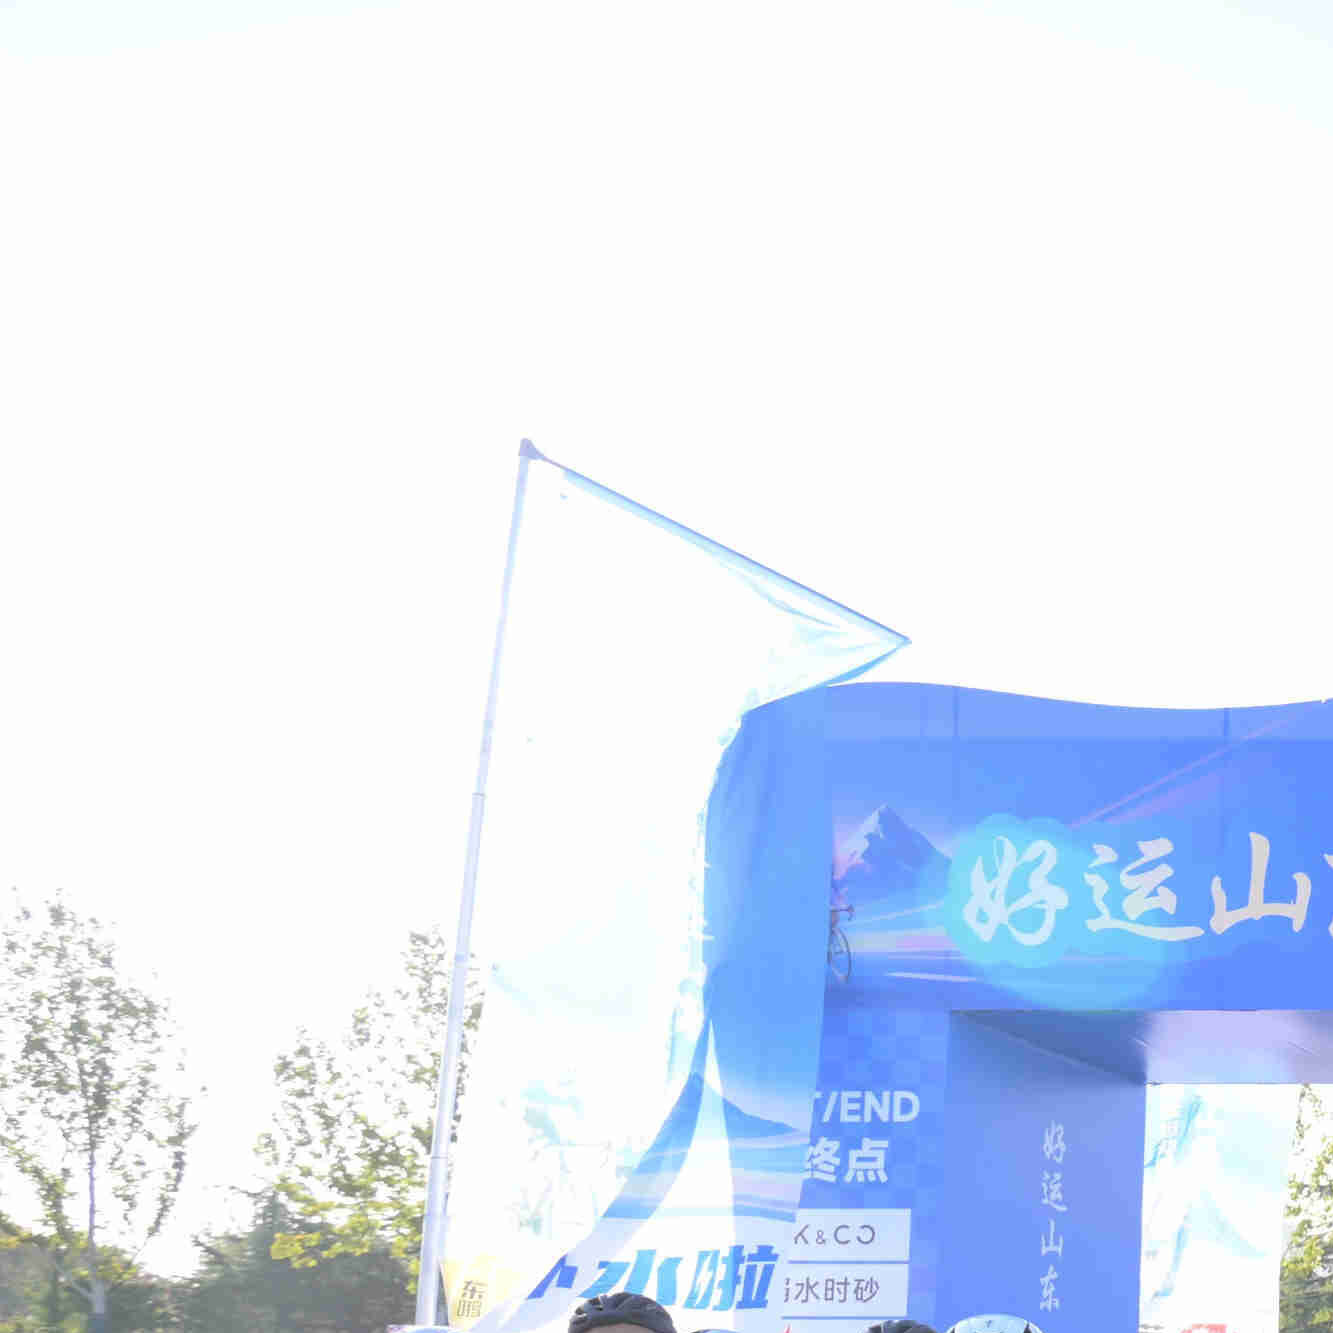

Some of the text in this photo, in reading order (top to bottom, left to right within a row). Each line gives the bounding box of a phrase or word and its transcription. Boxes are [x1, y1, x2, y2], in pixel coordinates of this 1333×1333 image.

[1039, 1120, 1068, 1312] 好运山东
[783, 1276, 880, 1304] 水时砂
